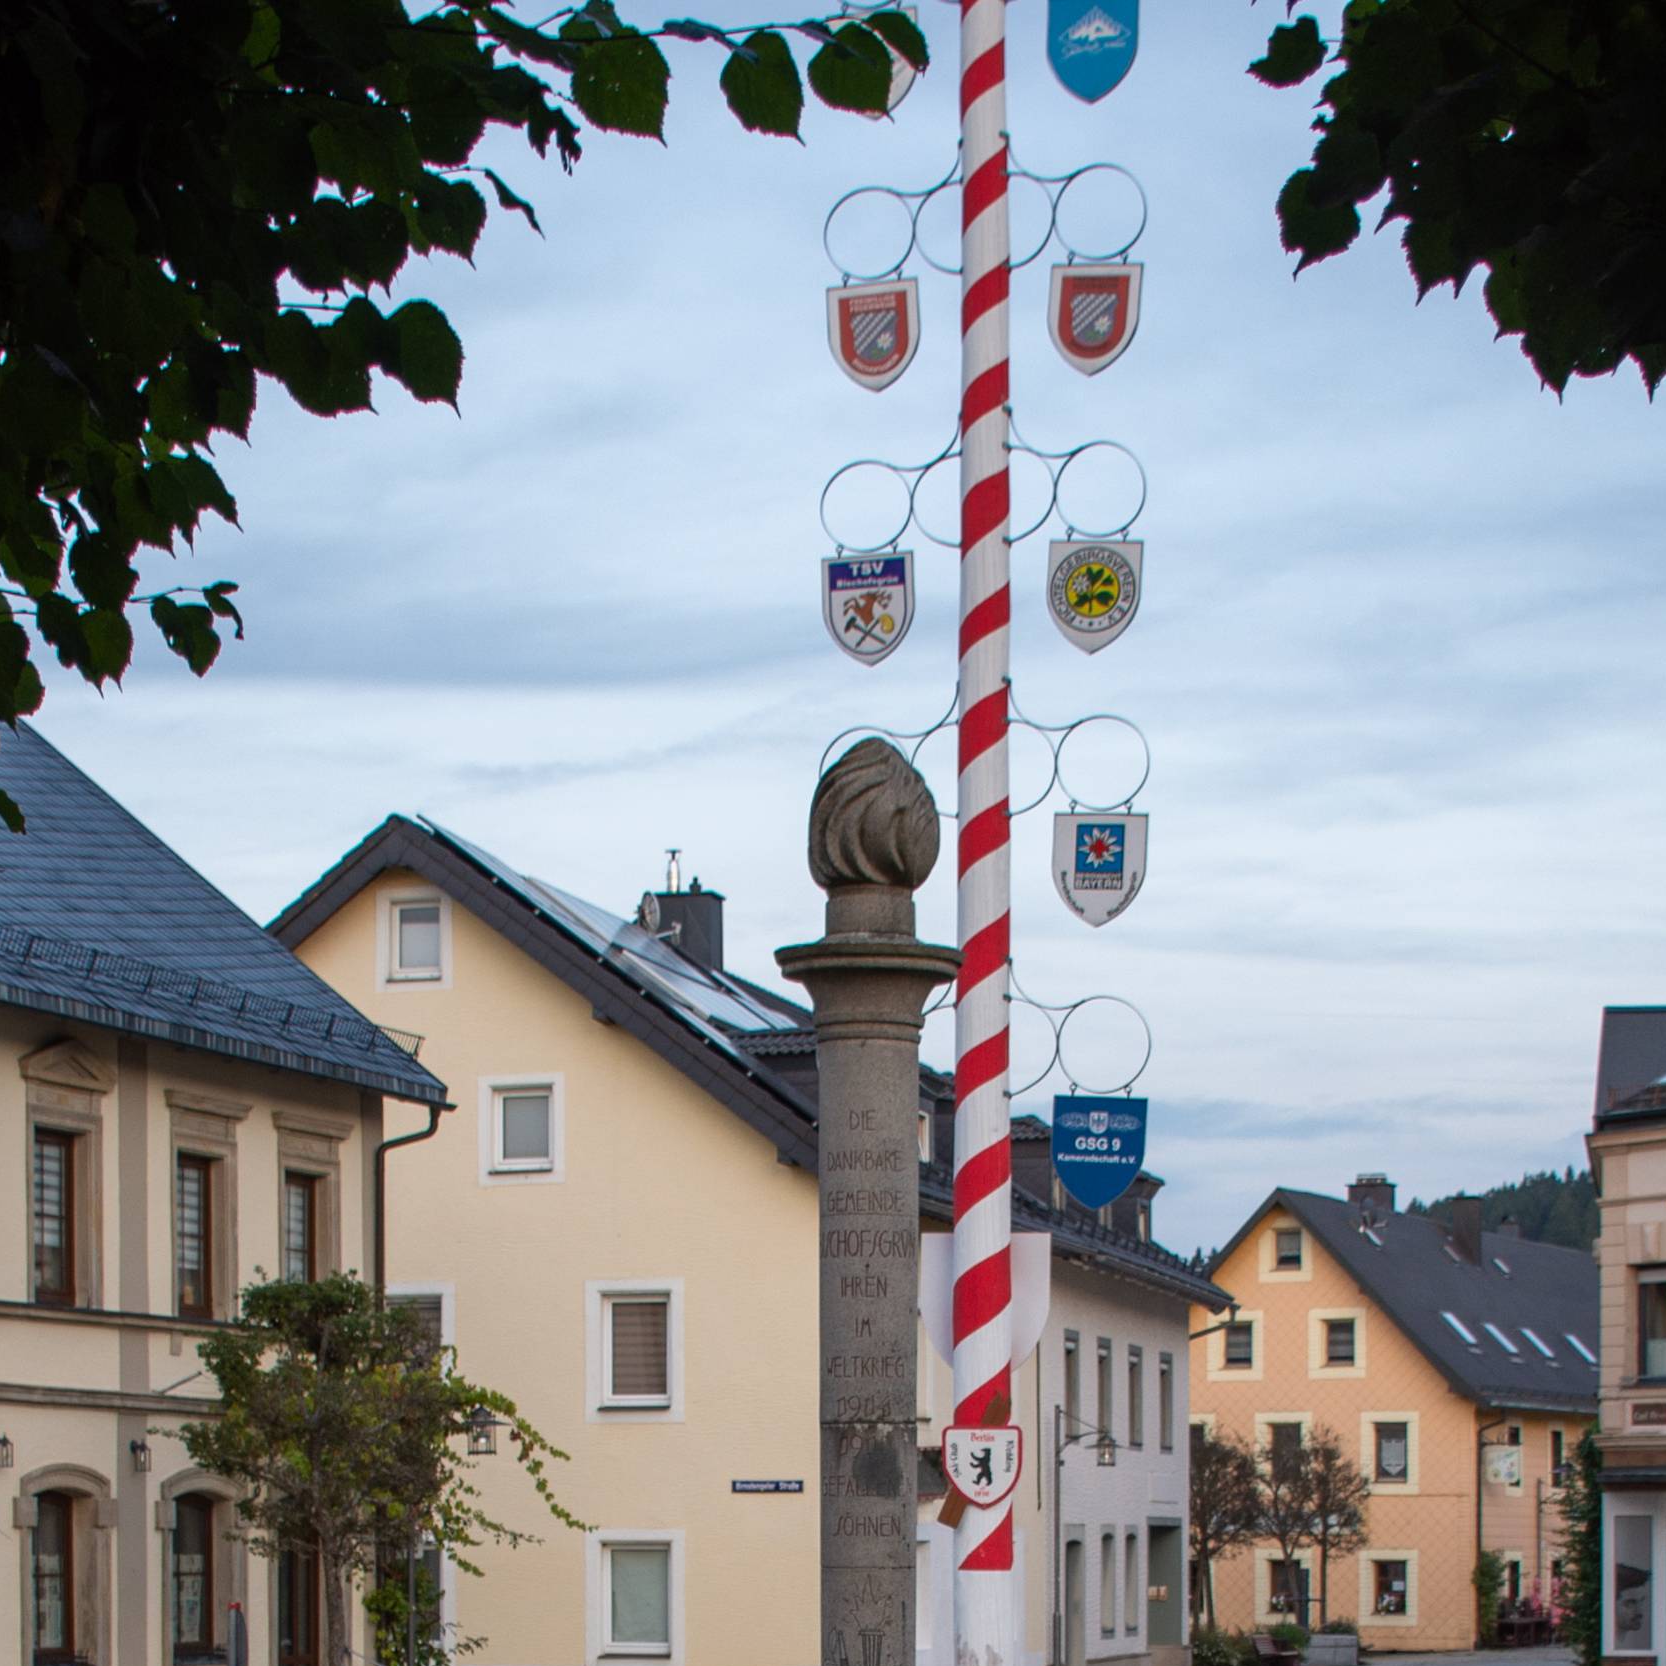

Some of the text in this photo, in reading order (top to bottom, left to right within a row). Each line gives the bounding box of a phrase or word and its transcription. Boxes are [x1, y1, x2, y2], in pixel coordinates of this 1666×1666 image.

[849, 560, 884, 577] TSV
[1074, 878, 1123, 890] BAYERN
[848, 1109, 878, 1132] DIE
[1074, 1136, 1121, 1152] GSG 9
[826, 1150, 906, 1173] DANKBARE
[1056, 1152, 1120, 1165] Kameradschaft
[827, 1189, 905, 1213] GEMEINDE
[840, 1275, 888, 1298] IHREN
[854, 1317, 872, 1338] IM
[833, 1511, 902, 1537] SÖHNEN
